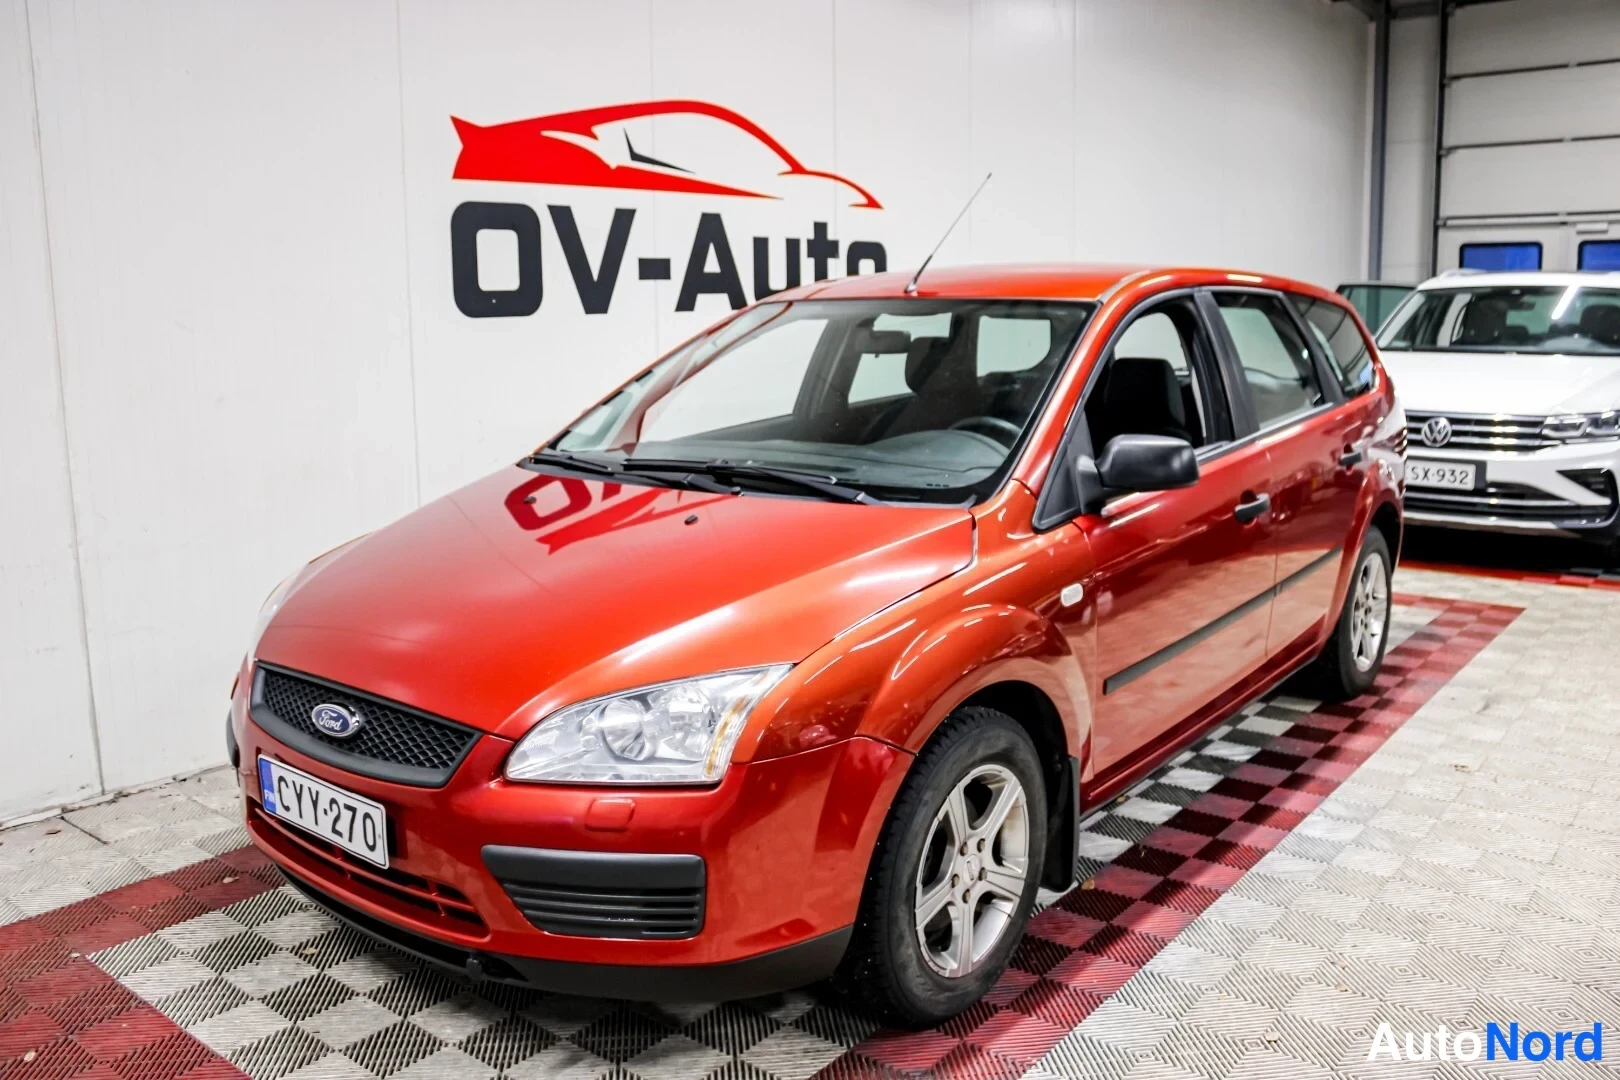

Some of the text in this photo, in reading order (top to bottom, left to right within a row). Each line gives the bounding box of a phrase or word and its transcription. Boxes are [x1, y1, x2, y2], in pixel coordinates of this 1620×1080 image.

[1405, 465, 1469, 486] SX-932
[318, 709, 344, 731] Ford
[277, 775, 378, 853] CYY-270
